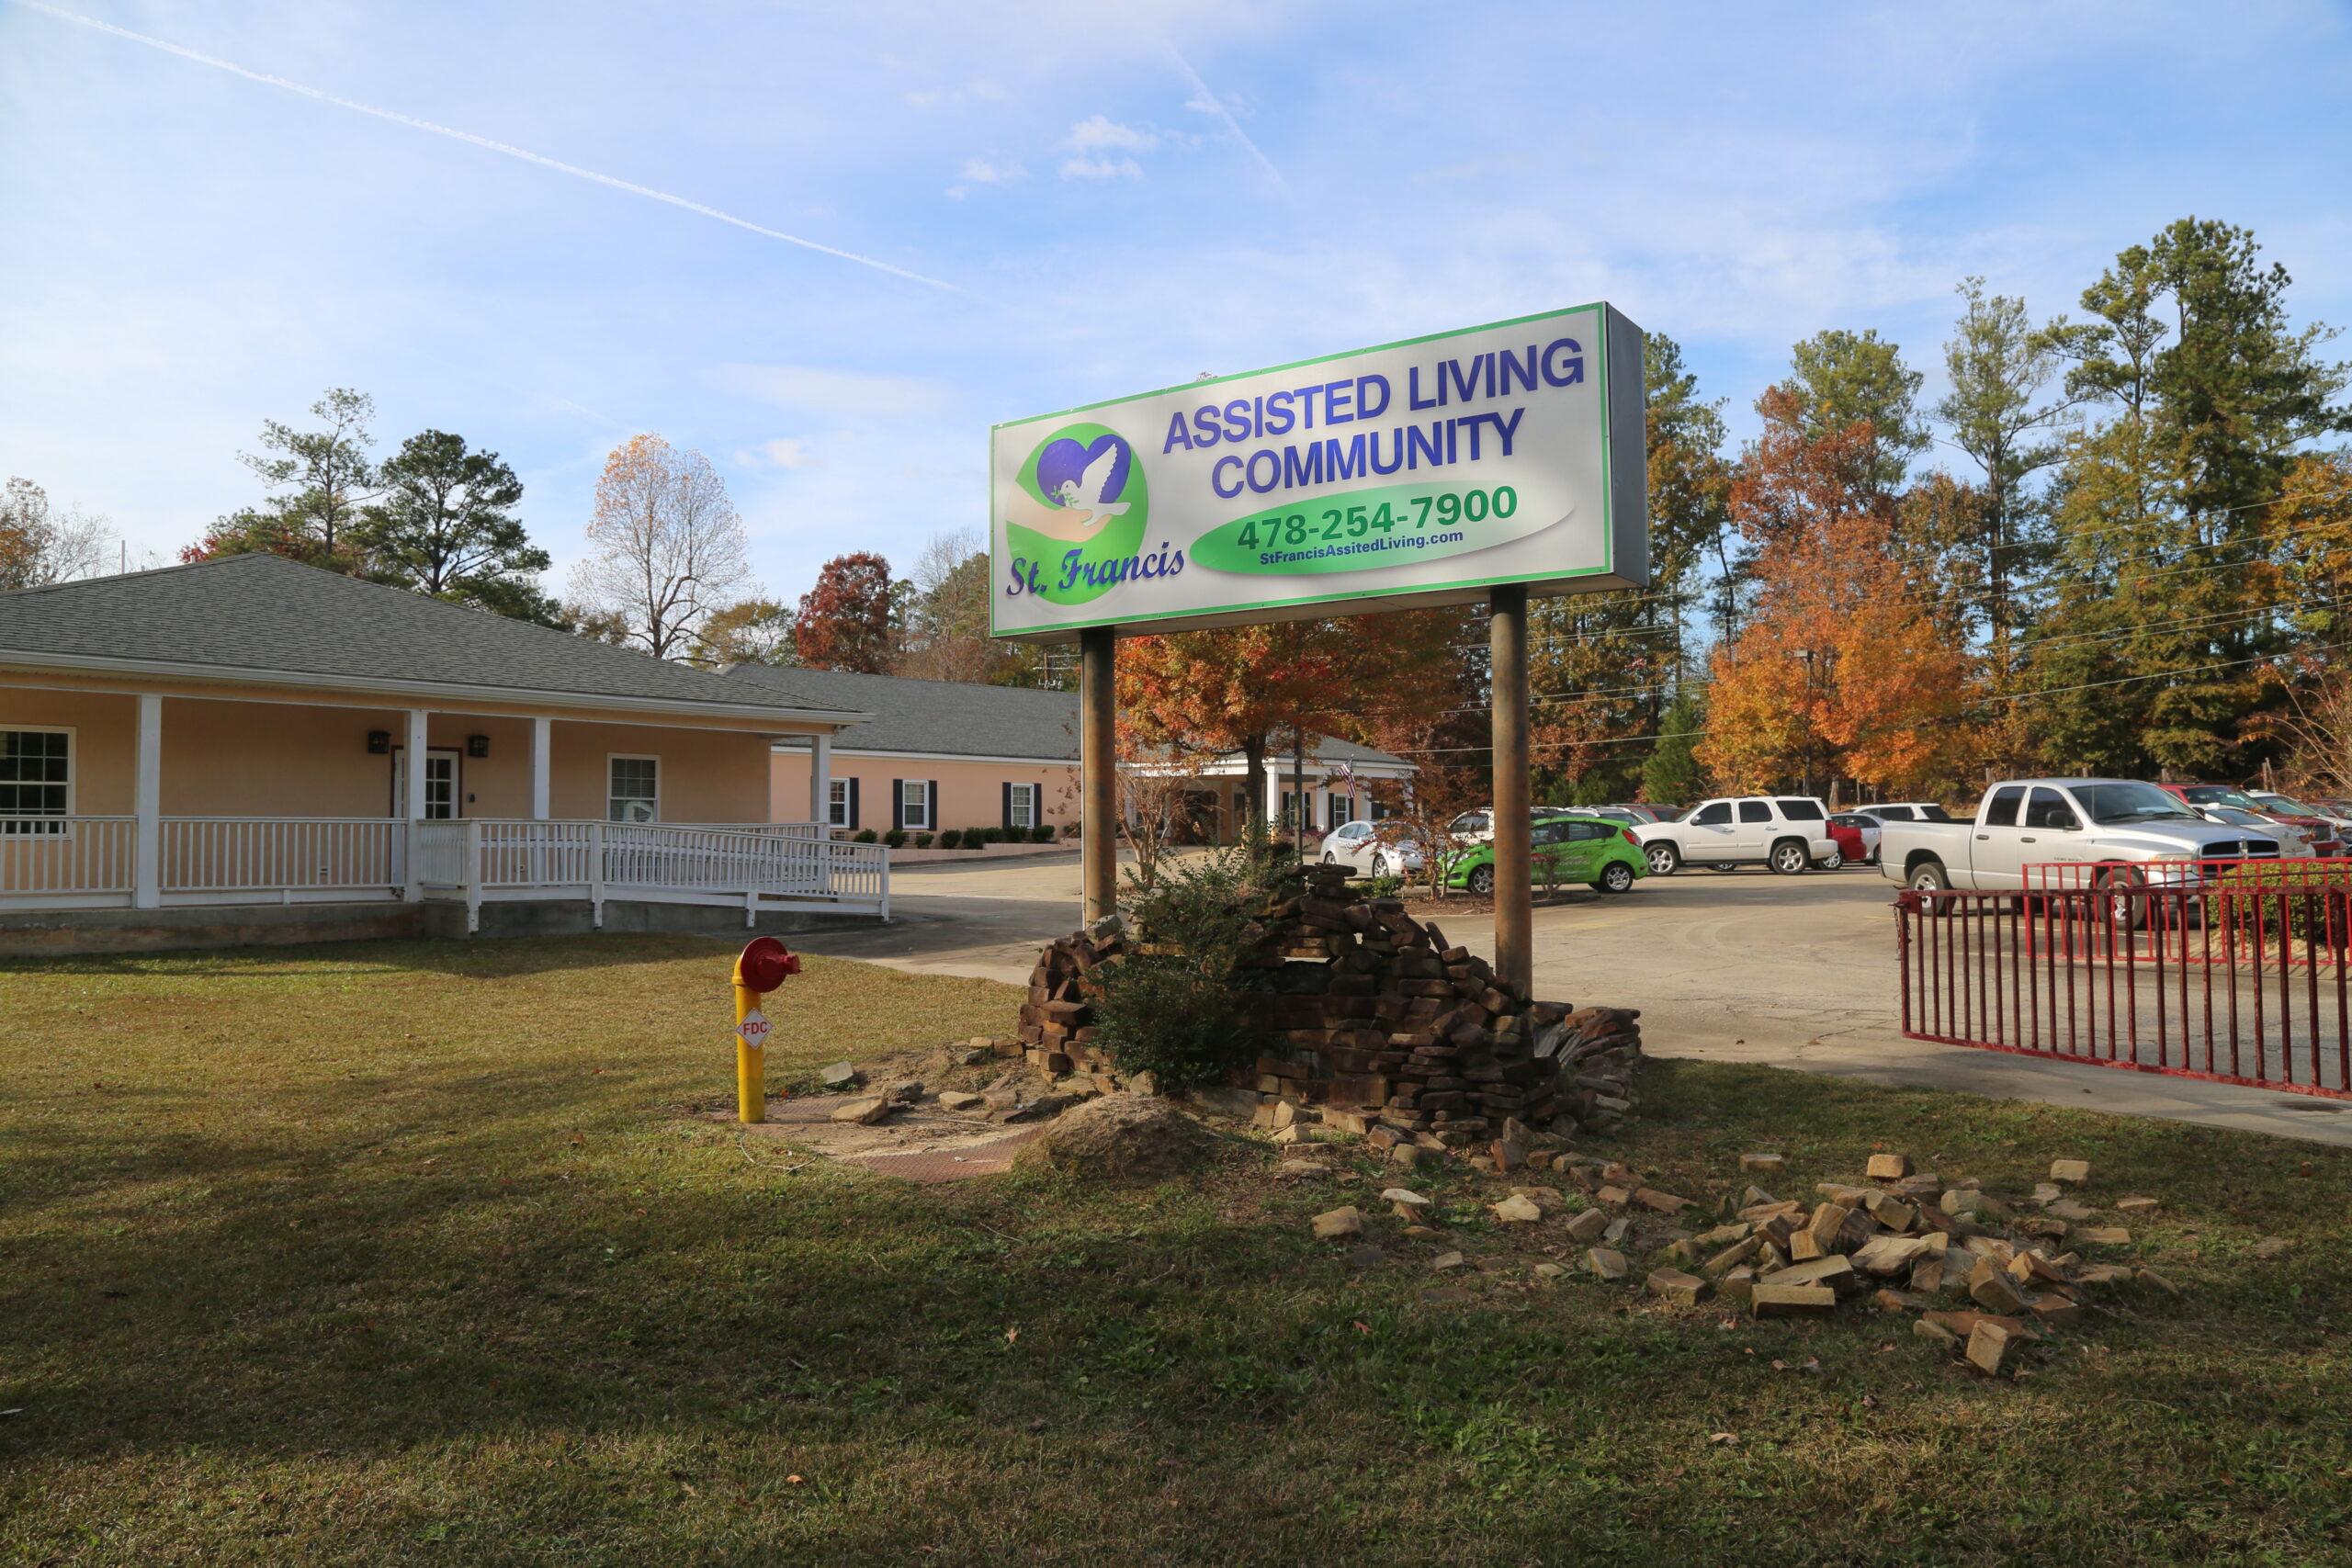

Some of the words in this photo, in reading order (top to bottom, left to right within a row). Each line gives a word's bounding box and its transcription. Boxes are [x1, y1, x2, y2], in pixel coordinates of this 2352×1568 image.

[1163, 374, 1391, 455] ASSISTED
[1409, 337, 1585, 412] LIVING
[1212, 407, 1526, 499] COMMUNITY
[1237, 485, 1518, 551] 478-254-7900
[1260, 531, 1464, 565] StFrancisAssitedLiving.com
[1006, 557, 1047, 595] St.
[1058, 541, 1185, 589] Francis
[742, 1021, 768, 1036] FDC
